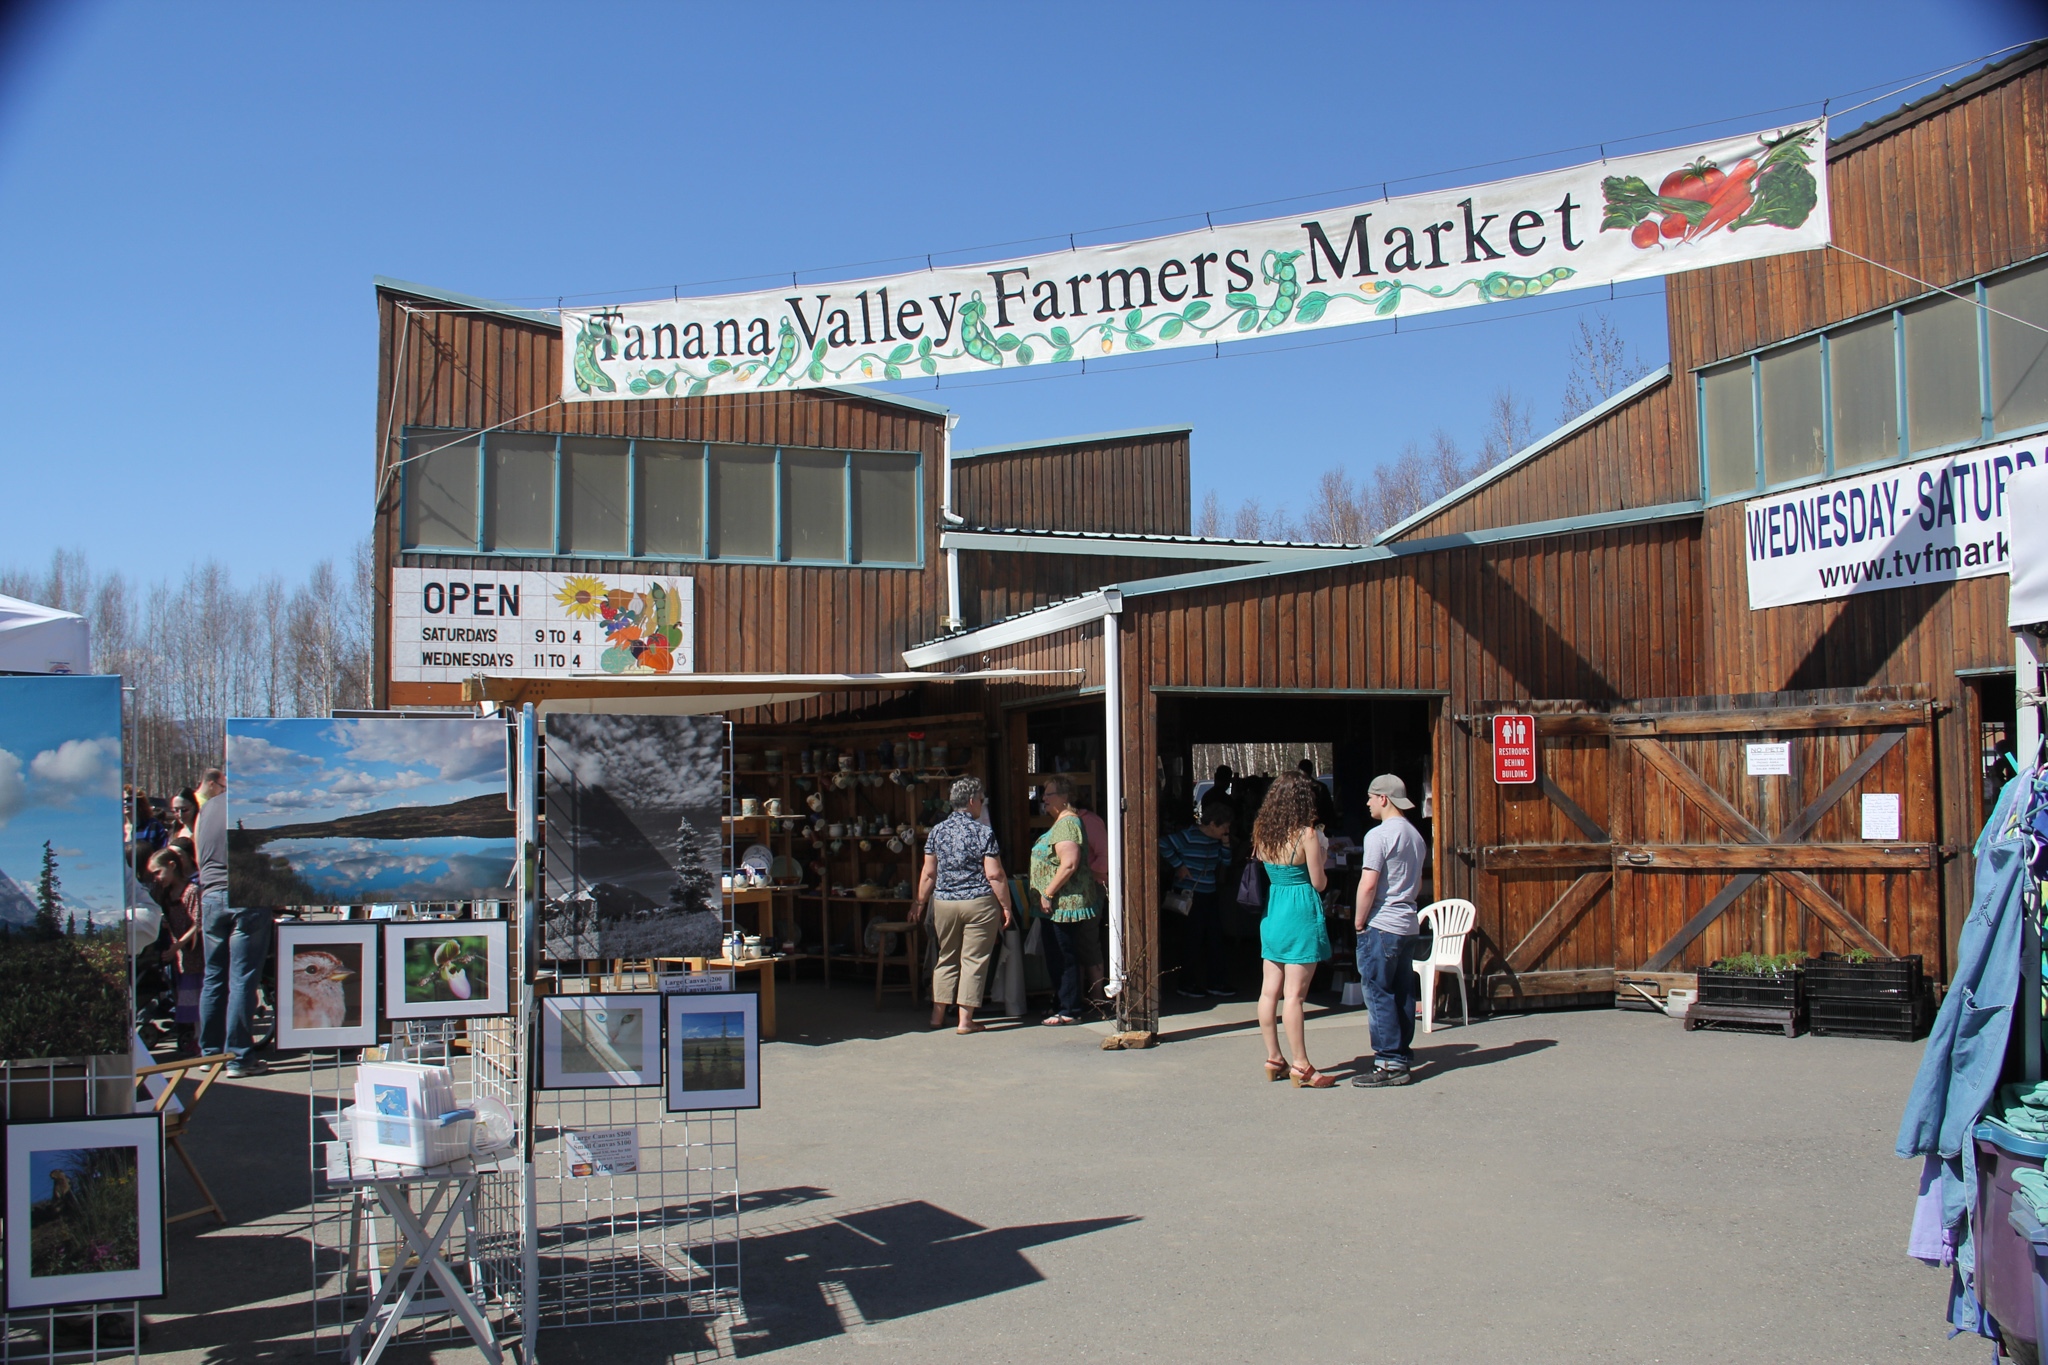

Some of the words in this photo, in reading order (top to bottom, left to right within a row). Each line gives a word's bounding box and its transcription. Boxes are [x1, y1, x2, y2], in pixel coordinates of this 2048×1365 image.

[590, 312, 775, 362] Tanana
[785, 287, 961, 351] Valley
[986, 247, 1254, 329] Farmers
[1300, 192, 1585, 286] Market
[1917, 447, 2048, 532] SATUR
[424, 582, 520, 616] OPEN
[422, 627, 497, 642] SATURDAYS
[535, 629, 544, 643] 9
[549, 630, 566, 643] TO
[572, 630, 582, 643] 4
[422, 652, 514, 667] WEDNESDAYS
[534, 654, 544, 667] 11
[549, 654, 566, 667] TO
[572, 654, 582, 667] 4
[1499, 748, 1530, 756] RESTROOMS
[1504, 759, 1525, 767] BEHIND
[1502, 770, 1528, 778] BUILDING
